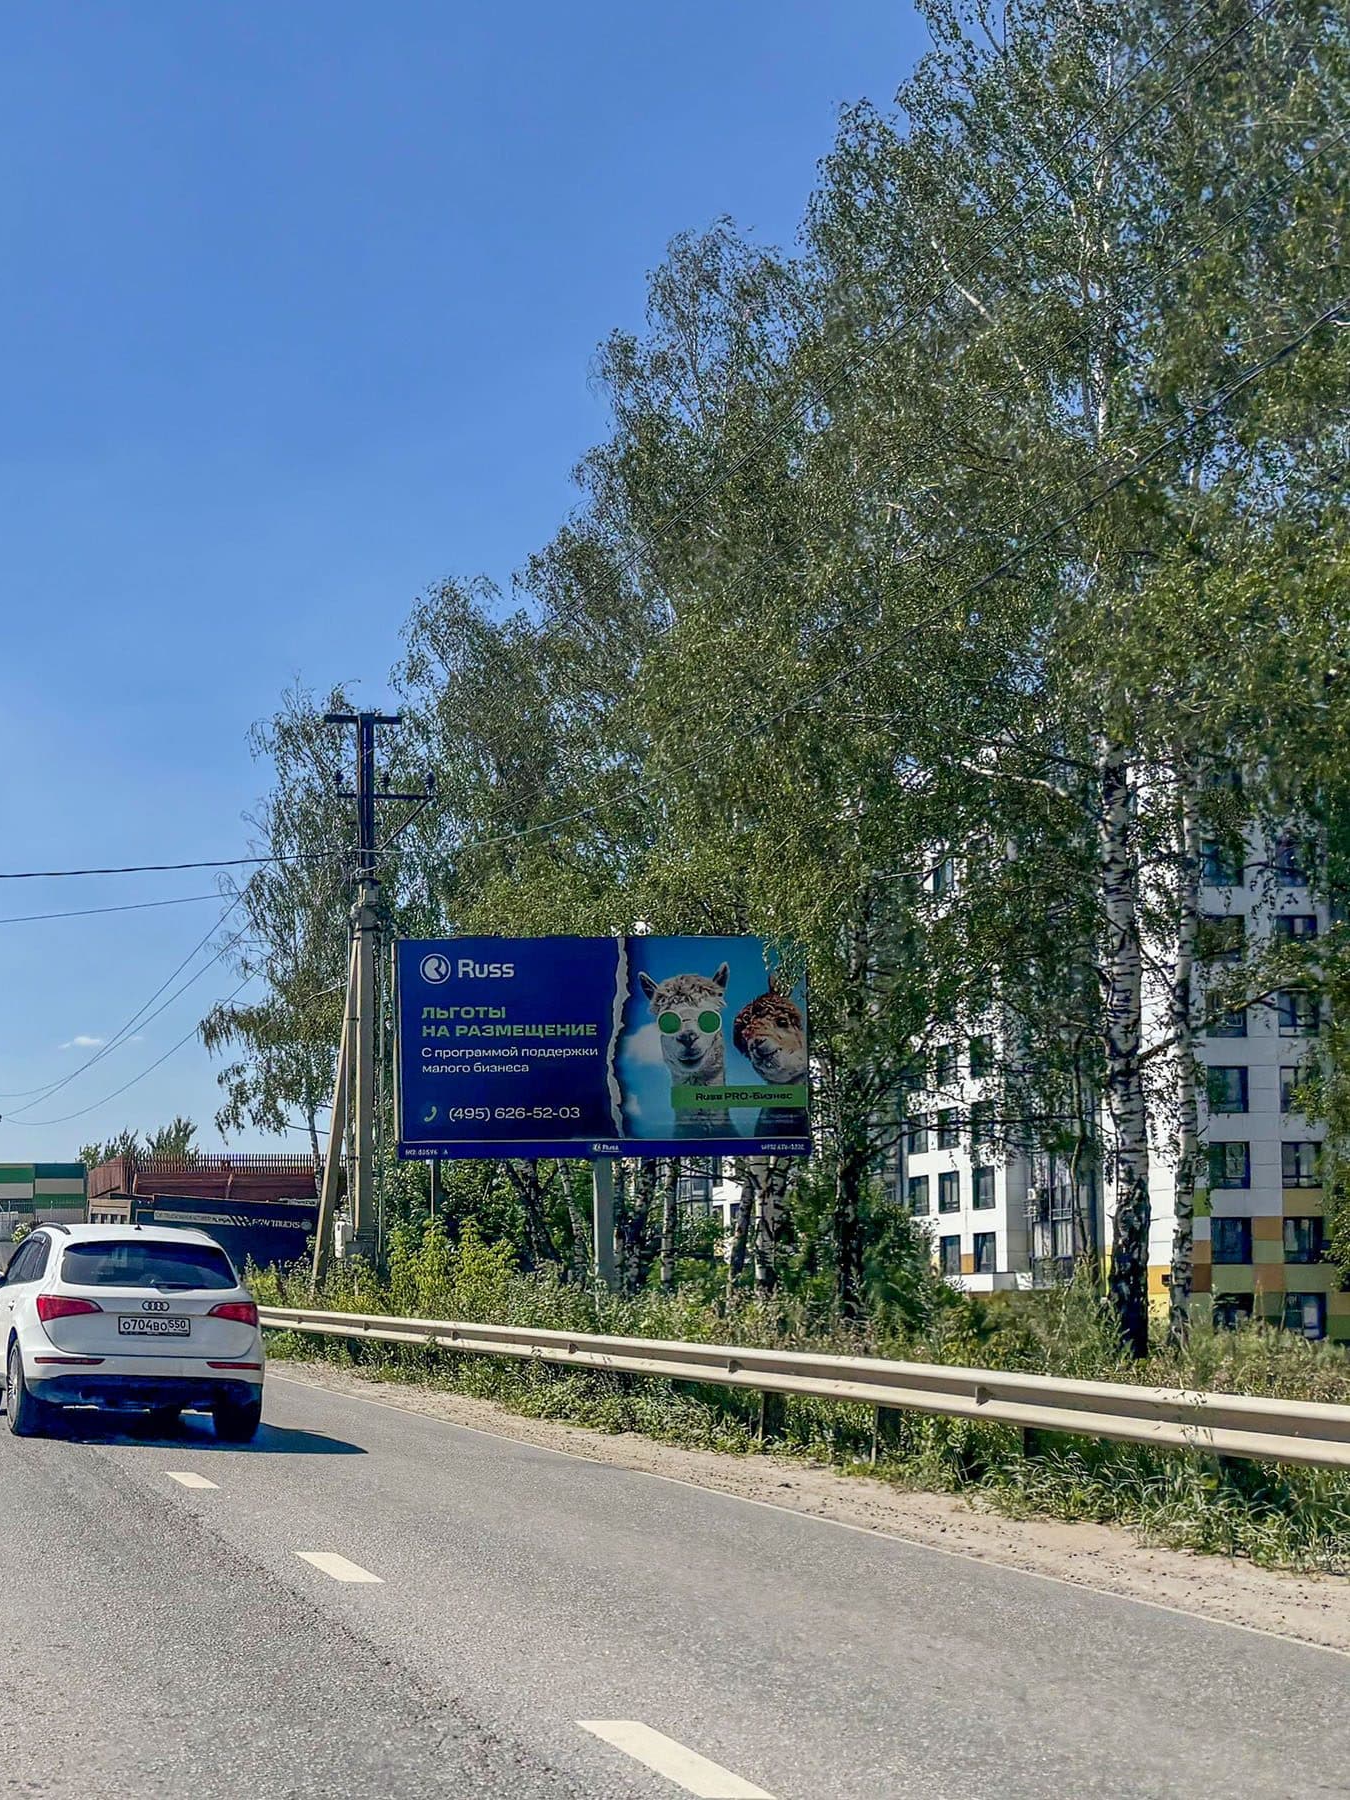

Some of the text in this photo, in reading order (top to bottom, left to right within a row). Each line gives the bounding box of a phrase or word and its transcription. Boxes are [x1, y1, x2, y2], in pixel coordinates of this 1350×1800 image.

[457, 959, 515, 978] Russ
[421, 1006, 506, 1019] ЛЬГОТЫ
[422, 1024, 598, 1038] НА РАЗМЕЩЕНИЕ
[421, 1046, 599, 1060] С программой поддержки
[422, 1062, 530, 1074] малого бизнеса
[449, 1107, 581, 1122] (495) 626-52-03
